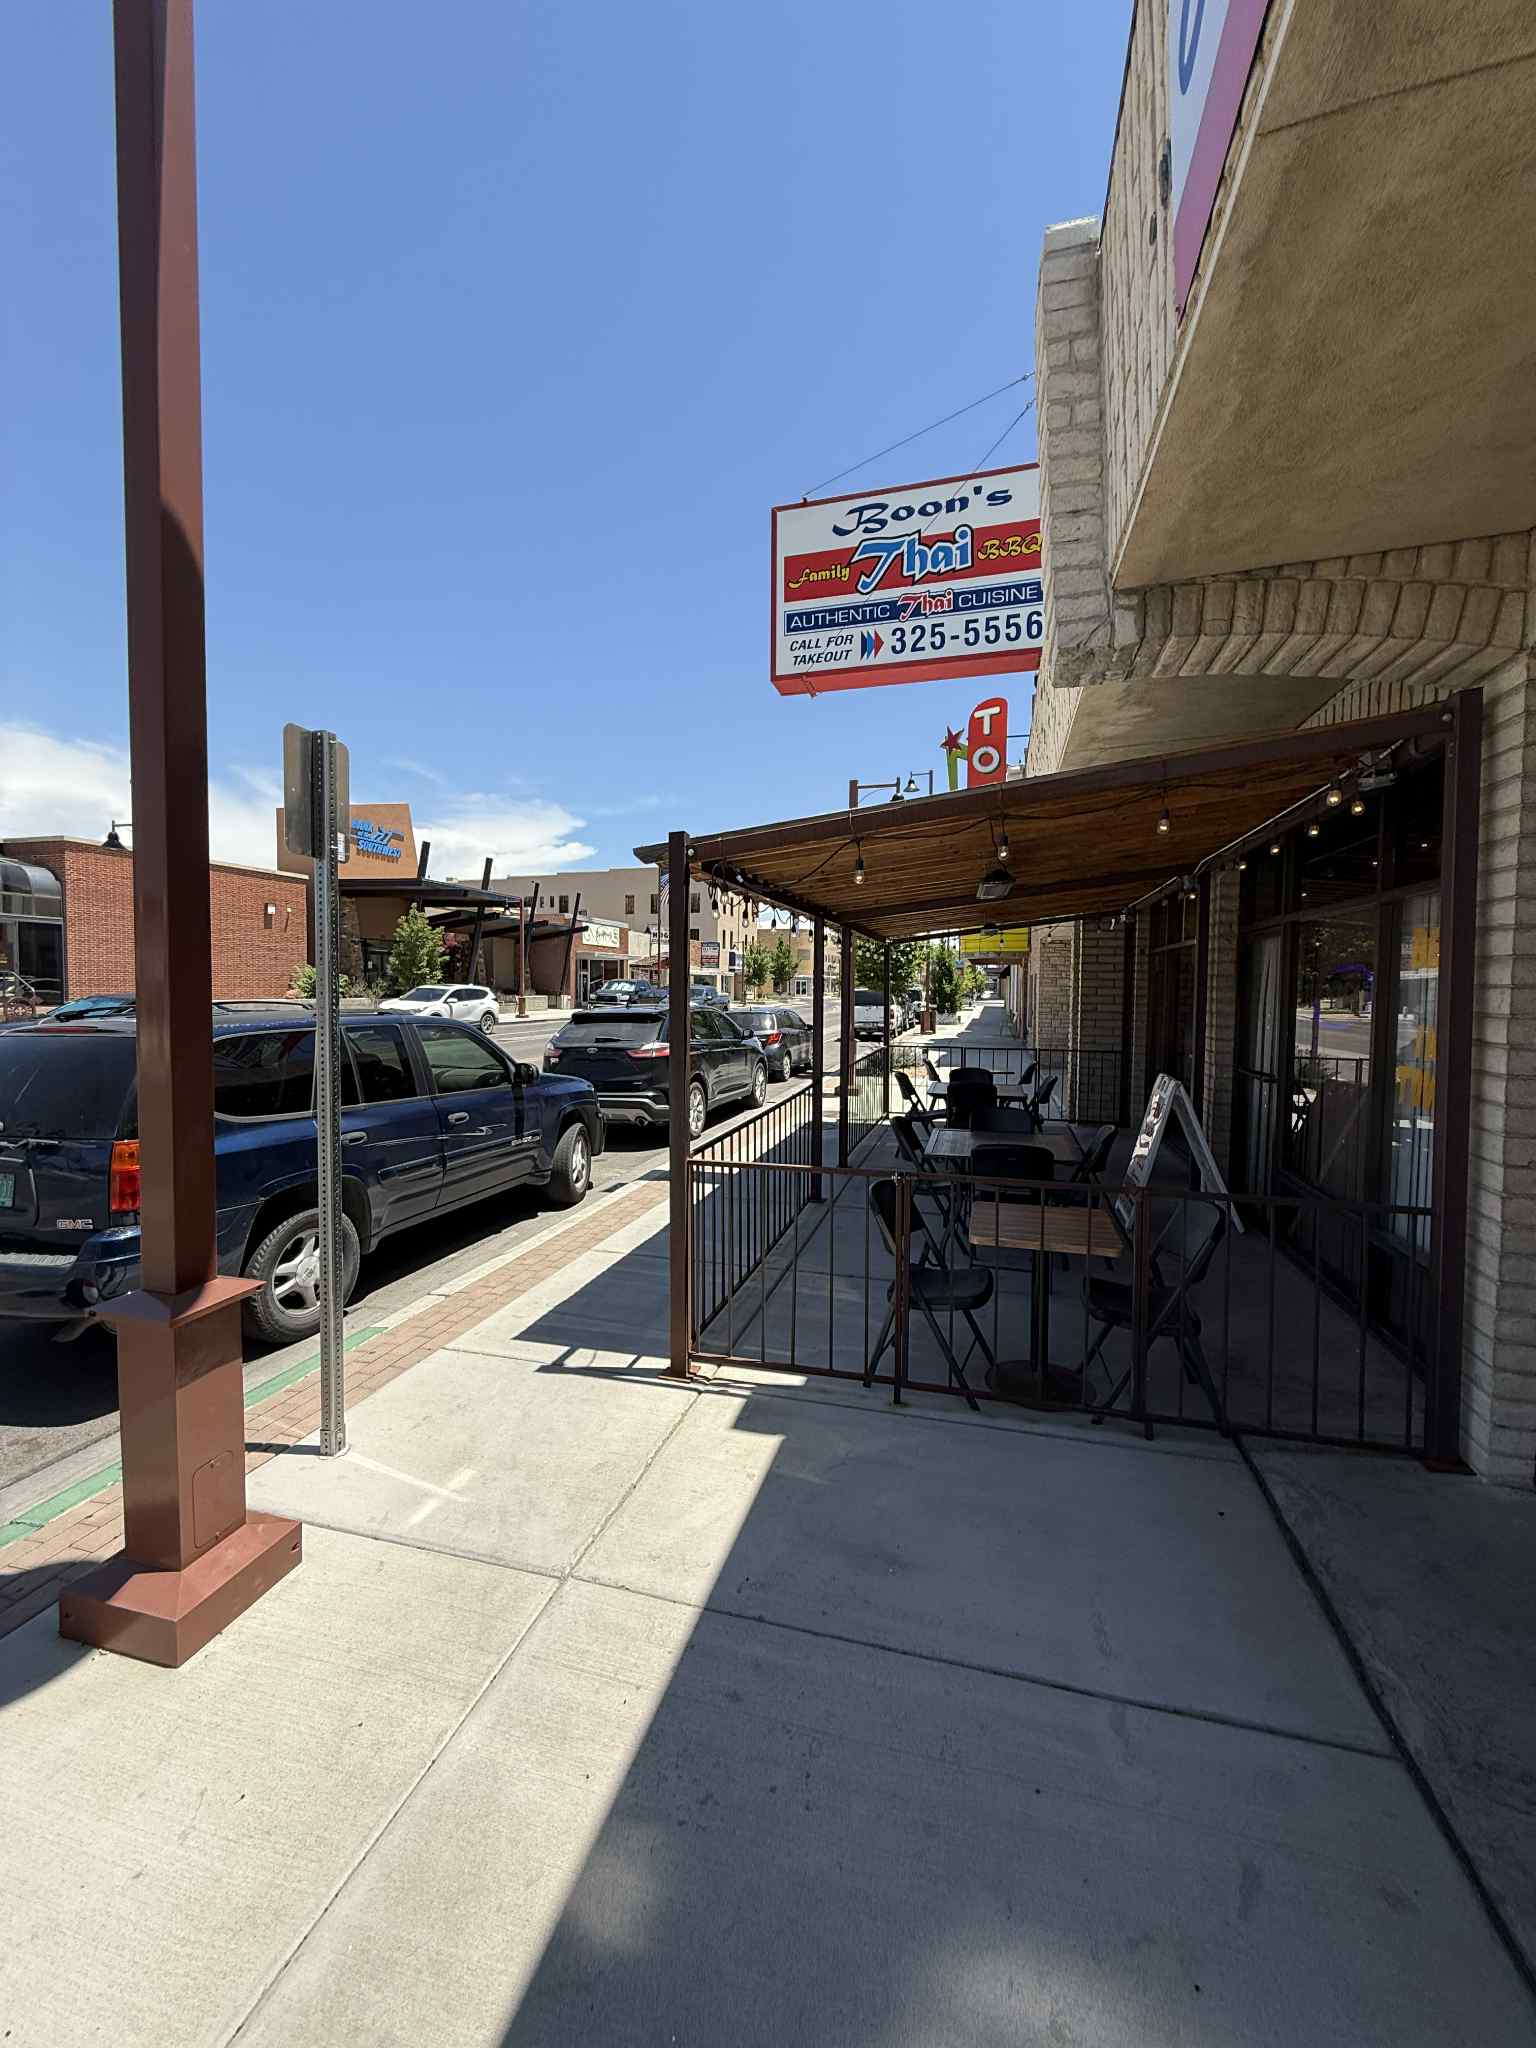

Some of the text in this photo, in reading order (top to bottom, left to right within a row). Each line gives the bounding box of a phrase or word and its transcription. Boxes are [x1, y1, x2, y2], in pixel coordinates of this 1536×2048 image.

[831, 485, 1013, 537] Boon's
[788, 525, 1043, 594] family Thai BBQ
[790, 584, 1039, 629] AUTHENTIC Thai CUISINE
[790, 634, 854, 652] CALL FOR
[891, 610, 1043, 655] 325-5556
[793, 649, 853, 666] TAKEOUT
[56, 1218, 94, 1230] GMC
